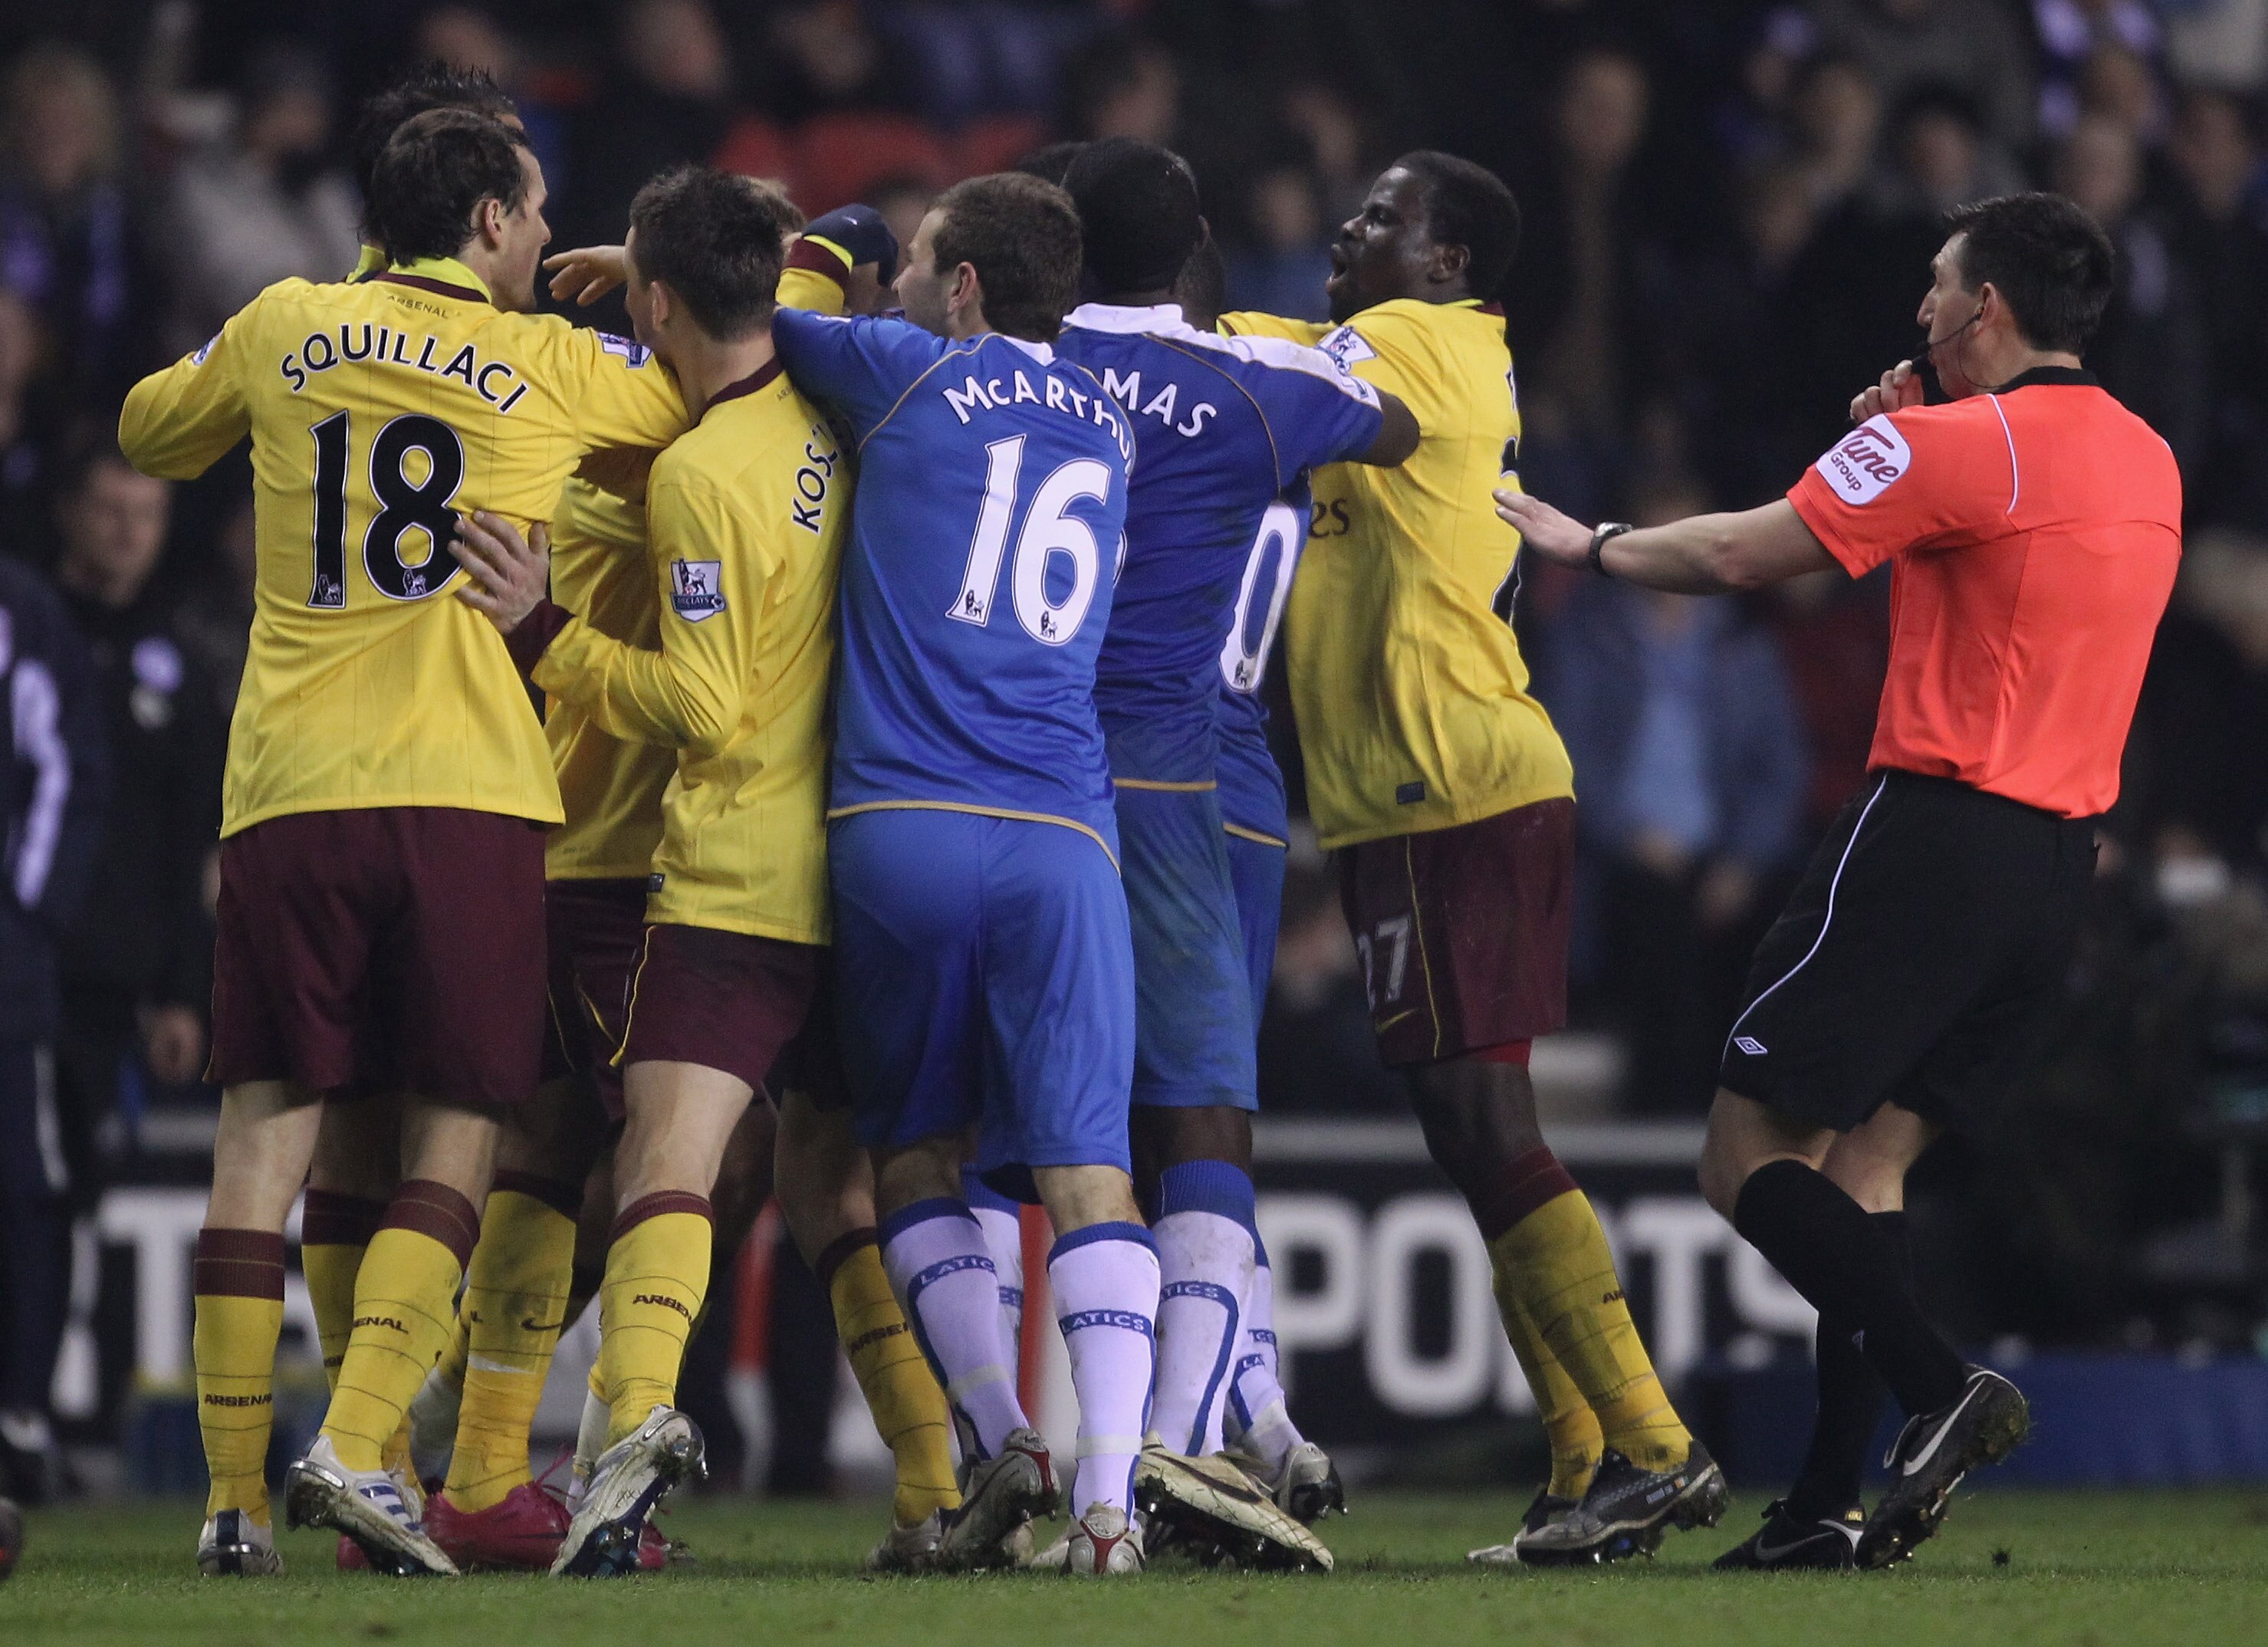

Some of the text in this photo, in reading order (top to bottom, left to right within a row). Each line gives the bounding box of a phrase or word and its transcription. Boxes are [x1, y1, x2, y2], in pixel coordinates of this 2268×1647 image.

[281, 323, 529, 414] SQUILLACI
[1827, 426, 1899, 491] Tune Group
[307, 409, 464, 609] 18
[945, 433, 1111, 646] 16
[1061, 1312, 1145, 1333] LATICS
